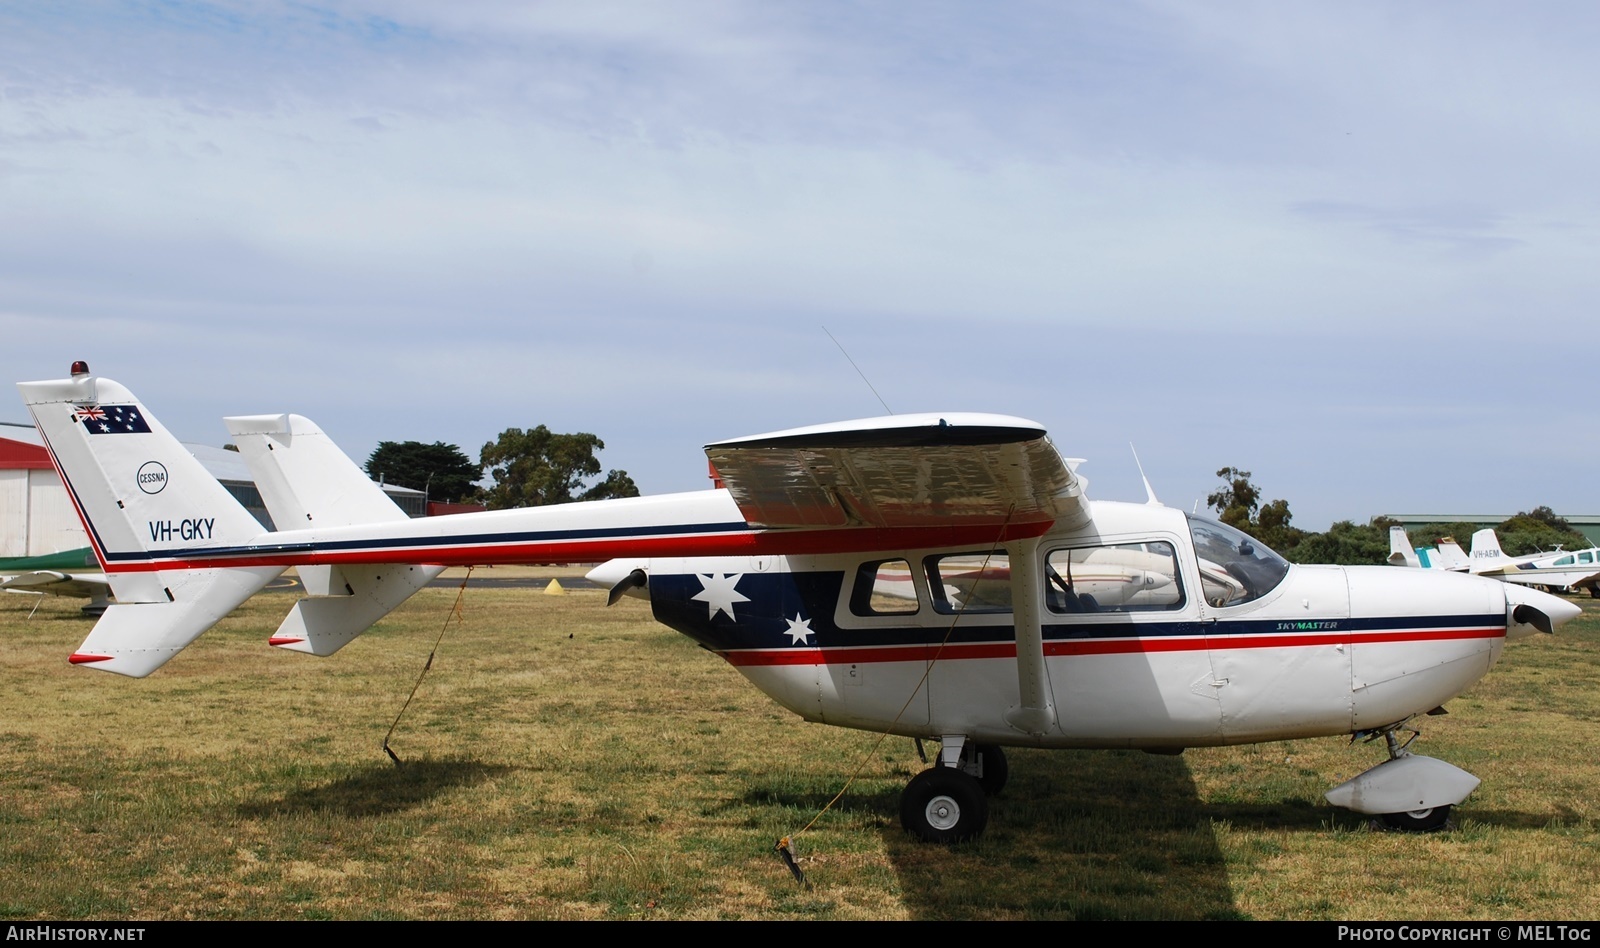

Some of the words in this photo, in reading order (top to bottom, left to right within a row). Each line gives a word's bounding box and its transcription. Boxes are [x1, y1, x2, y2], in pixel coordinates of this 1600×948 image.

[140, 472, 165, 484] CESSNA
[149, 518, 215, 542] VH-GKY
[1473, 549, 1500, 559] VH-AEM
[1277, 621, 1338, 630] SKYMASTER
